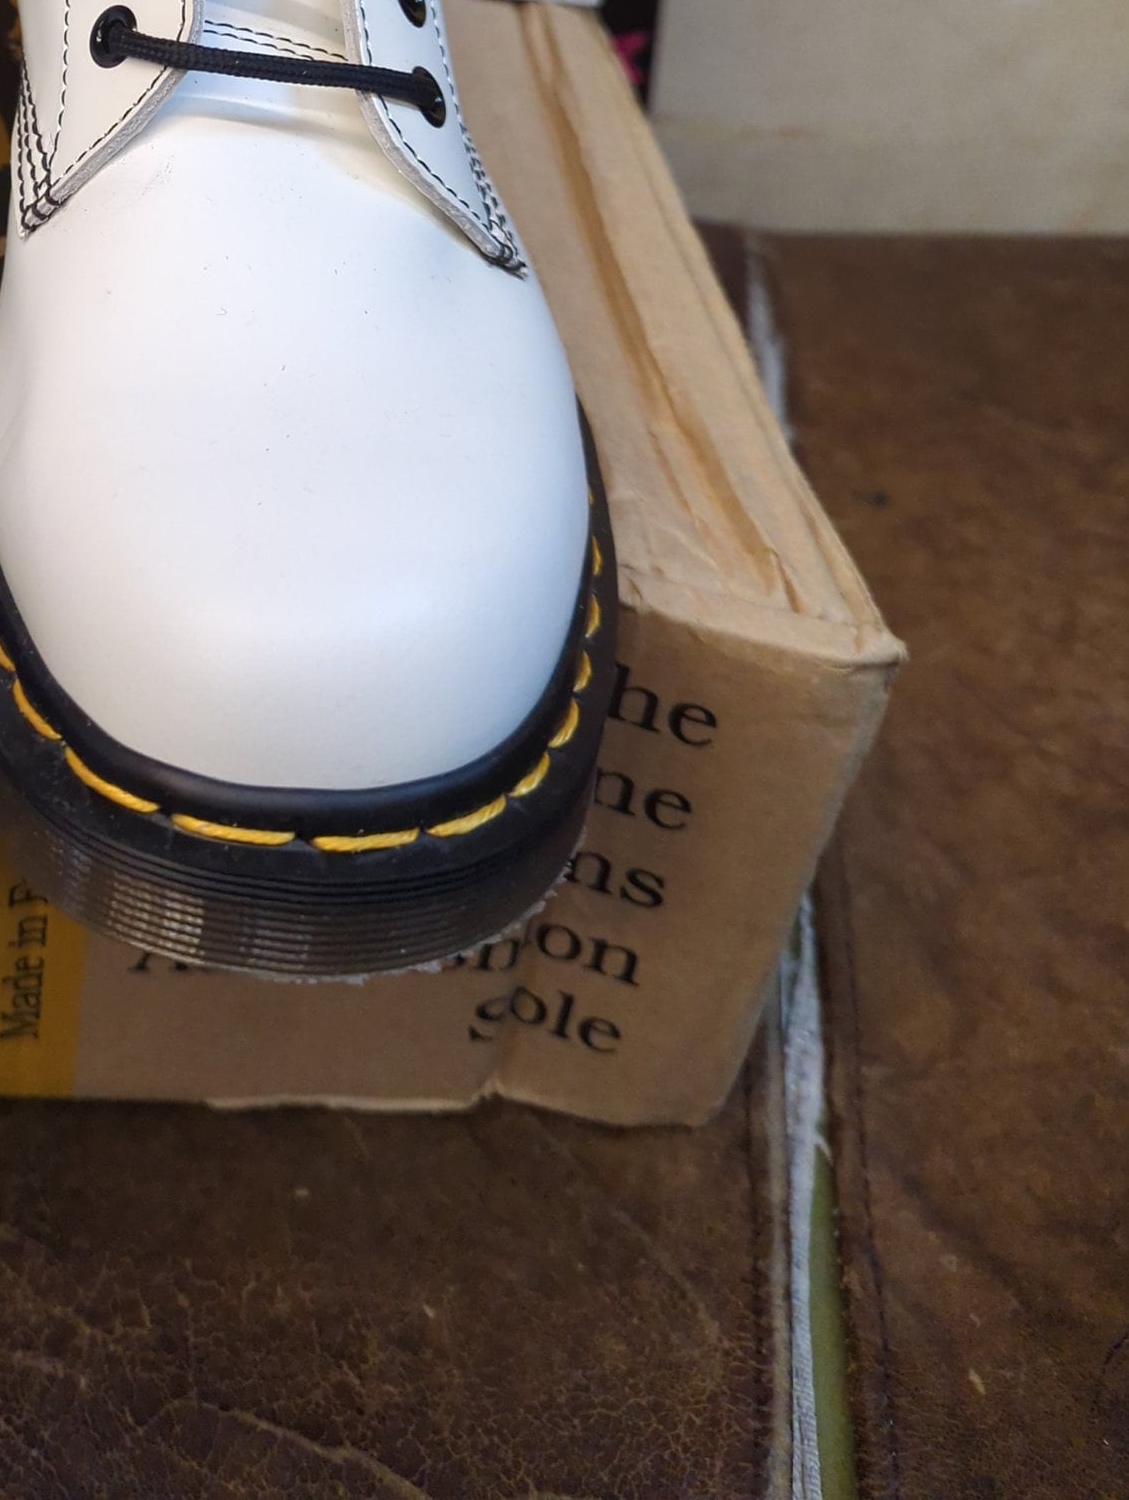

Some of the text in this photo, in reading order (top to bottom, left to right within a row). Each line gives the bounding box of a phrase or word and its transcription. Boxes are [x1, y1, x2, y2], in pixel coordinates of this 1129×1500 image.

[605, 661, 717, 747] he
[7, 914, 48, 949] in
[0, 956, 45, 1043] Made
[468, 986, 623, 1054] sole
